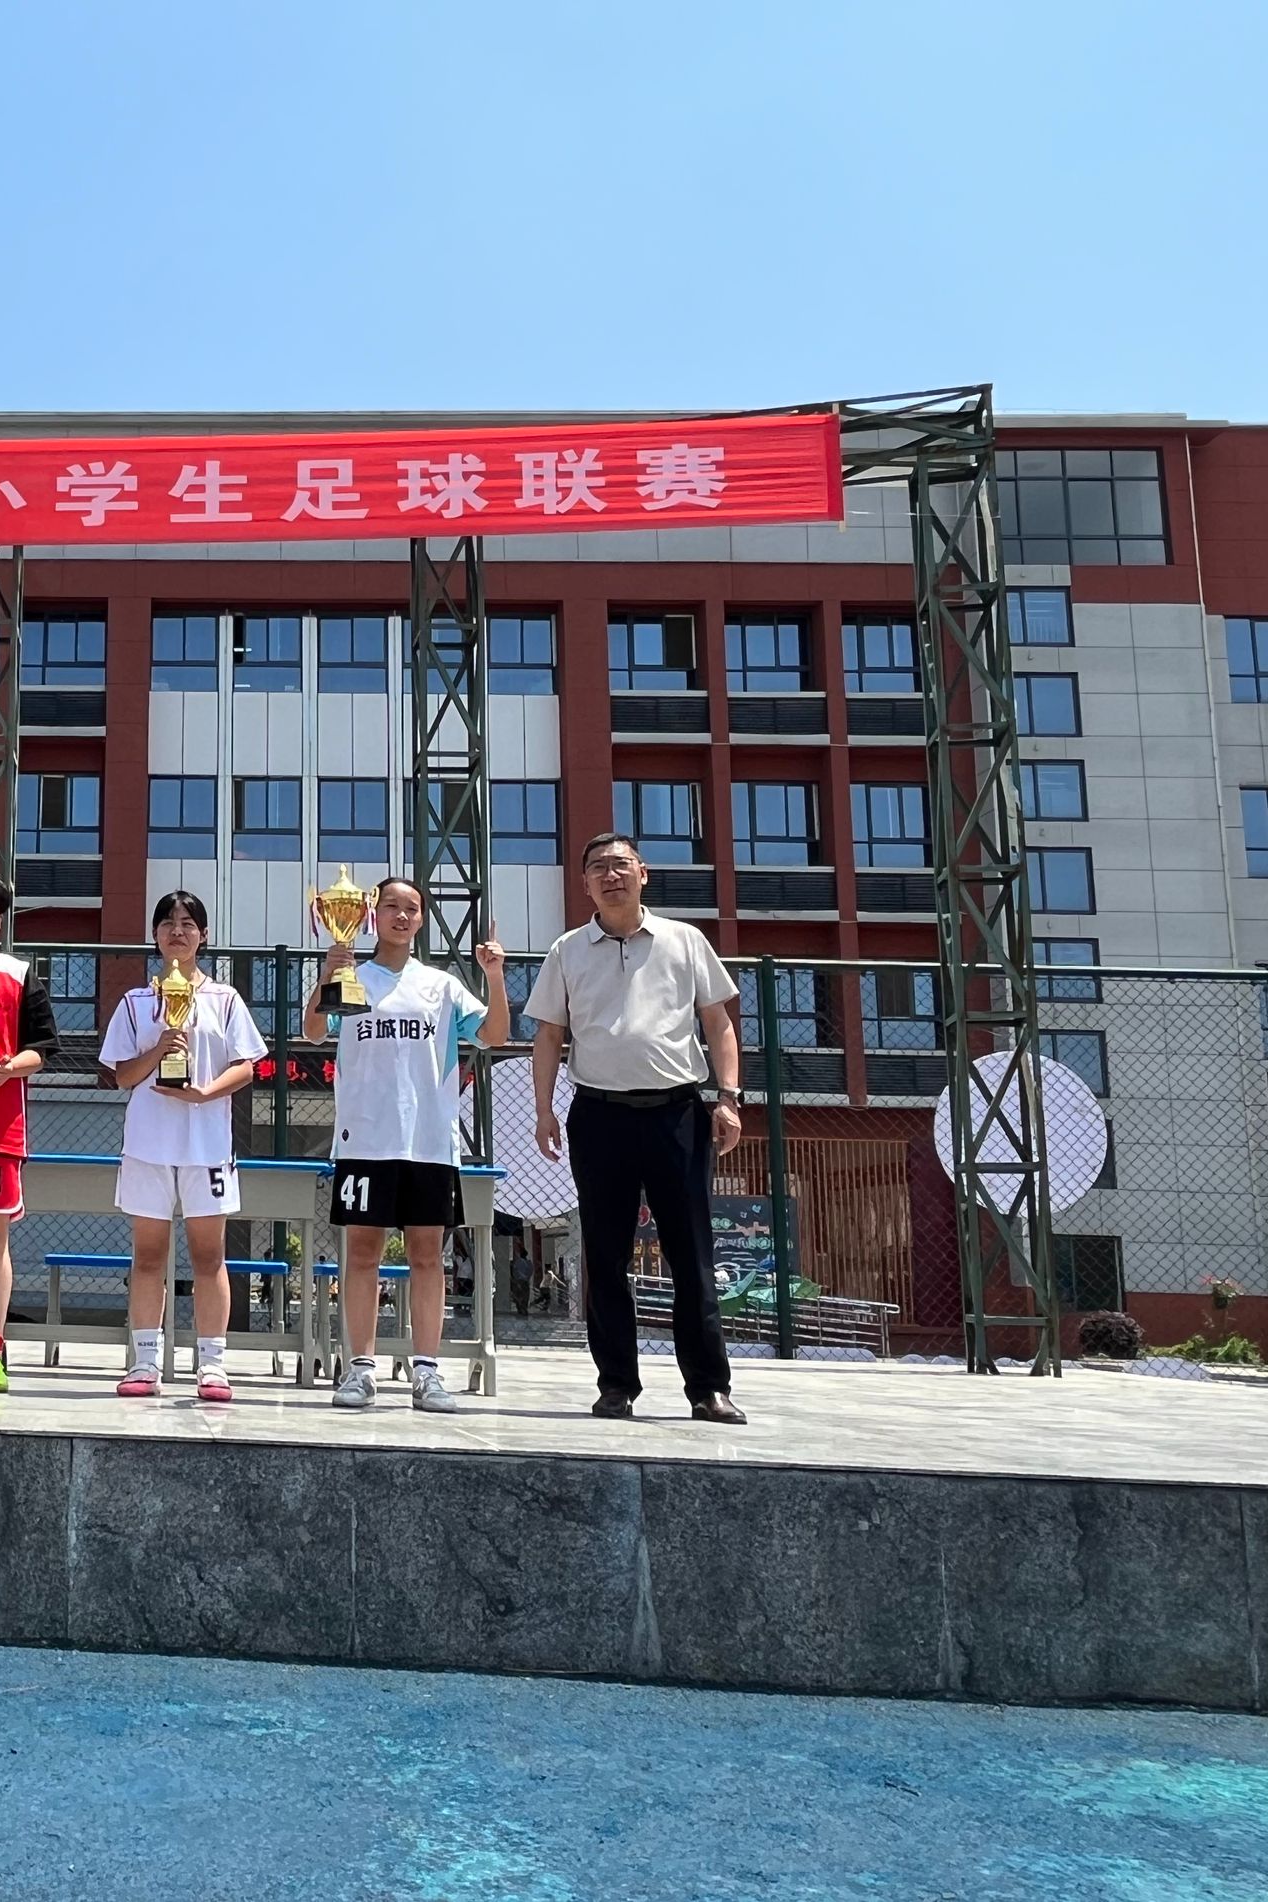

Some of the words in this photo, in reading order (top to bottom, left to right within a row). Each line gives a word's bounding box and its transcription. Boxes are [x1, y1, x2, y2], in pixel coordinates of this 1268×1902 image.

[356, 1019, 436, 1041] 谷城阳光
[208, 1167, 225, 1198] 5
[341, 1175, 370, 1211] 41
